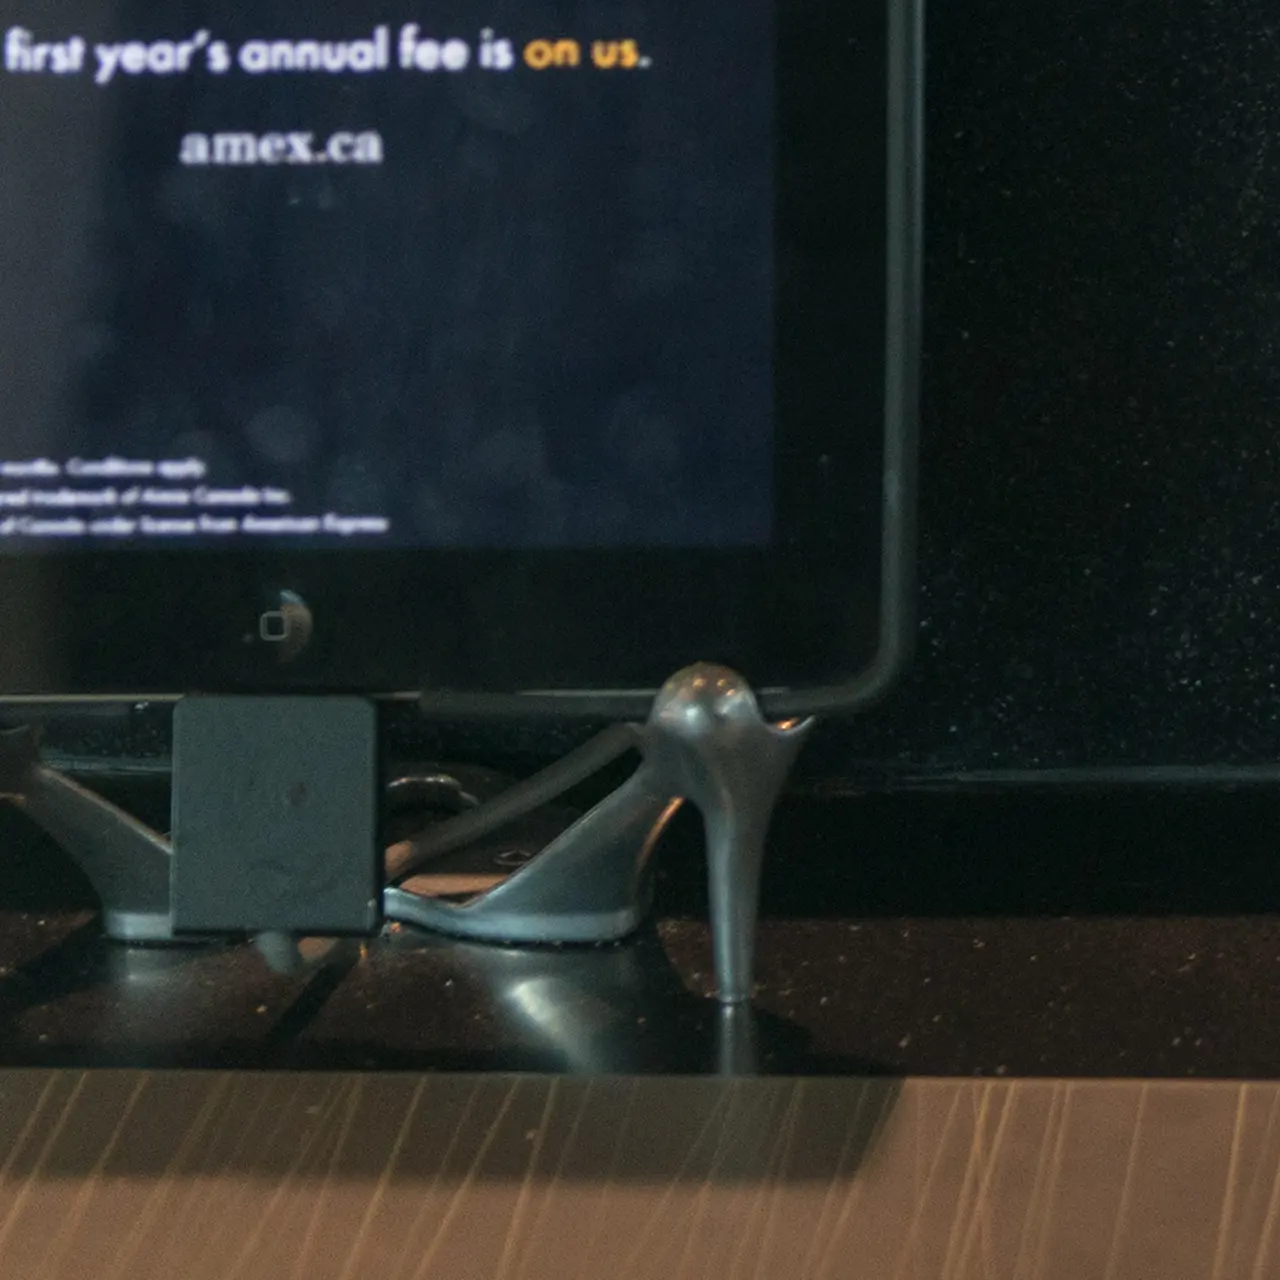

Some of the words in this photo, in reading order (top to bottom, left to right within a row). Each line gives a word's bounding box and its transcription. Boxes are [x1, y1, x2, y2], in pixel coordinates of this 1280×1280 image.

[4, 26, 85, 74] first
[93, 30, 231, 84] year's
[238, 25, 389, 74] annual
[398, 23, 469, 71] fee
[479, 29, 514, 70] is
[524, 40, 579, 69] on
[592, 40, 651, 69] us.
[180, 132, 383, 164] amex.ca
